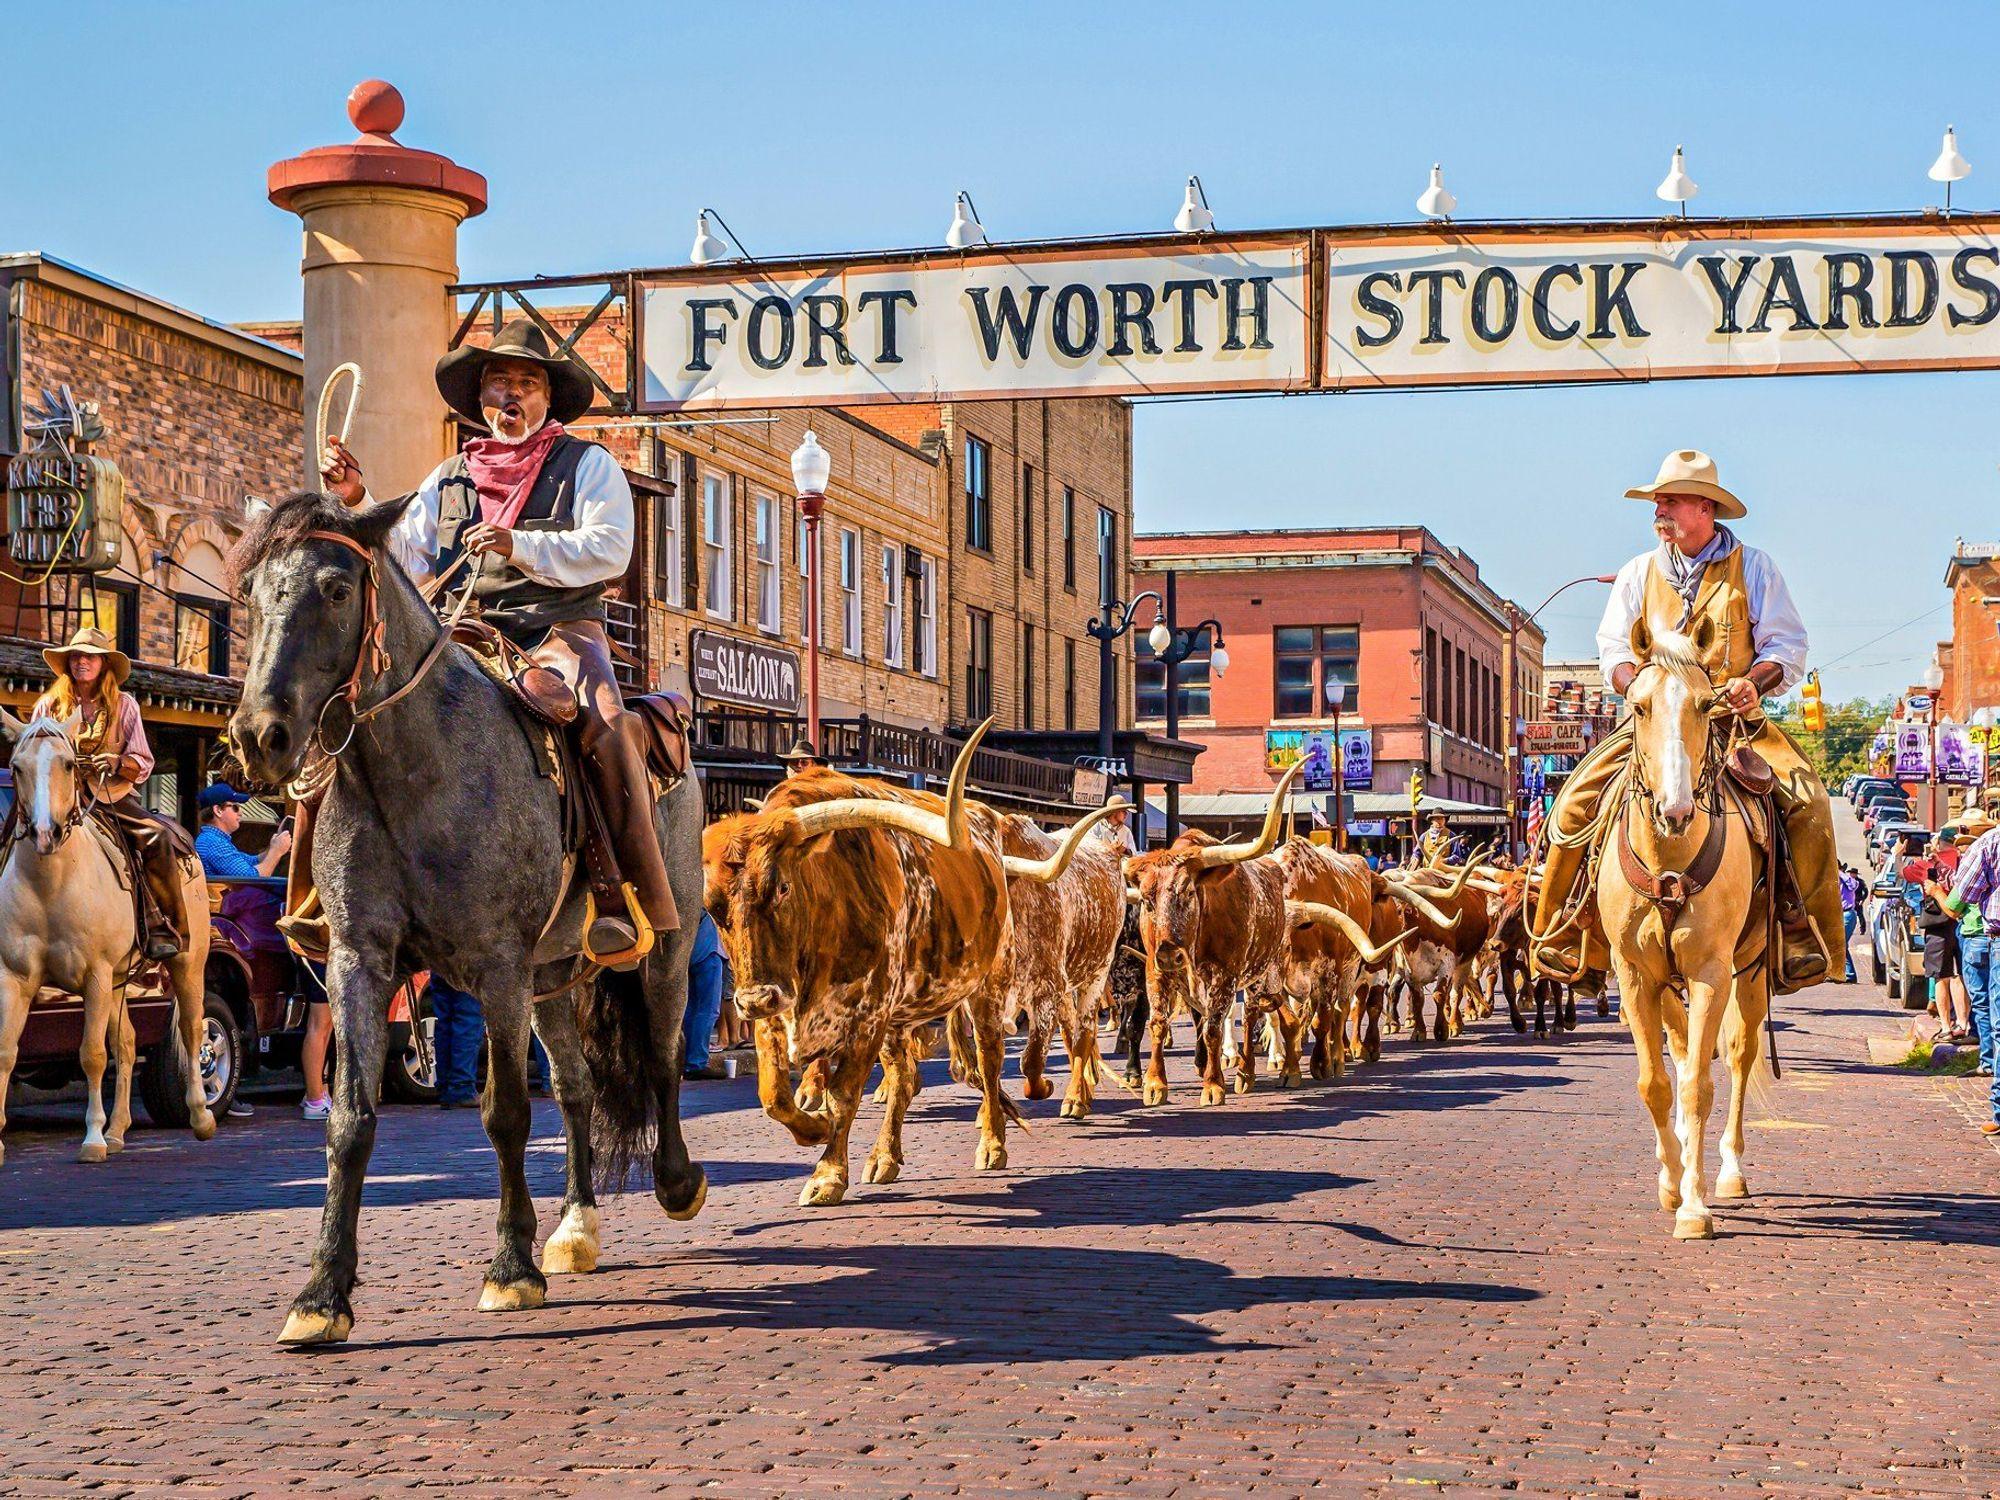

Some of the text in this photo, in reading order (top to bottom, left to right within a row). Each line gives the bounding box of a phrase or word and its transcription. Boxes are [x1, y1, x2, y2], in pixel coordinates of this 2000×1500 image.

[685, 247, 2000, 371] FORT WORTH STOCK YARDS
[716, 645, 780, 700] SALOON
[1526, 724, 1583, 739] STAR CAFE
